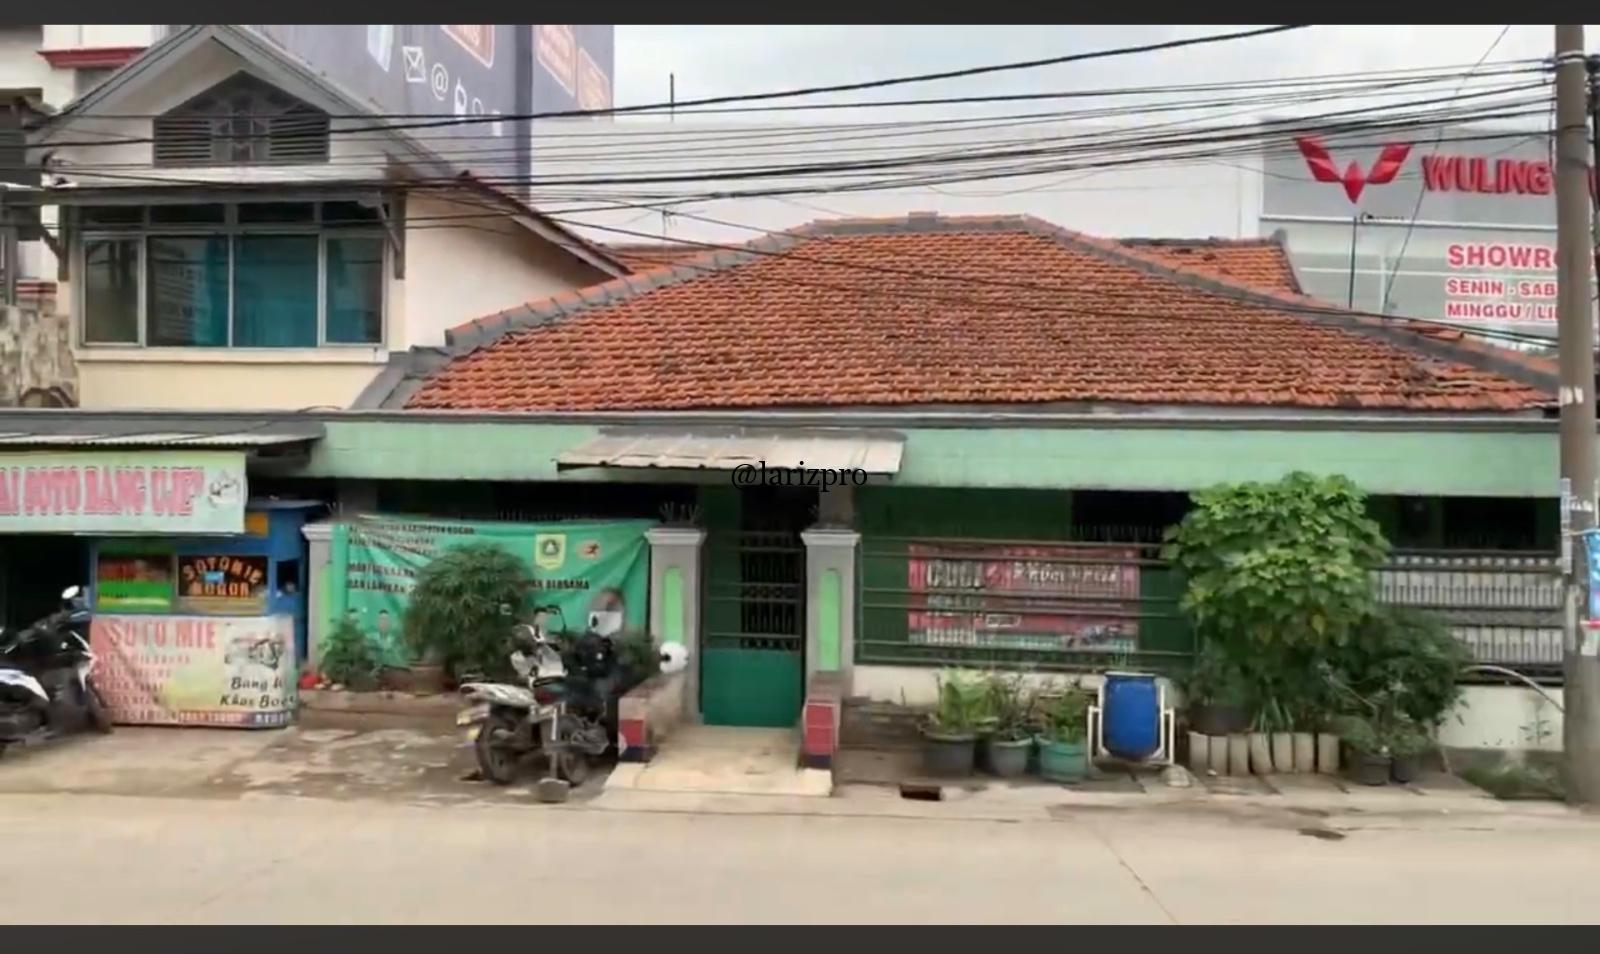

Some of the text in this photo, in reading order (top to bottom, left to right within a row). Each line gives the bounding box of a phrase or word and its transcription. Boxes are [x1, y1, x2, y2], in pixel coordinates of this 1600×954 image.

[1420, 155, 1551, 195] WULING
[1447, 279, 1502, 294] SENIN
[1520, 282, 1557, 296] SAB
[1447, 303, 1521, 319] MINGGU
[1537, 306, 1559, 319] LI
[24, 466, 81, 517] SOTO
[84, 466, 146, 517] BANG
[175, 620, 216, 649] MIE
[231, 676, 268, 691] Bang
